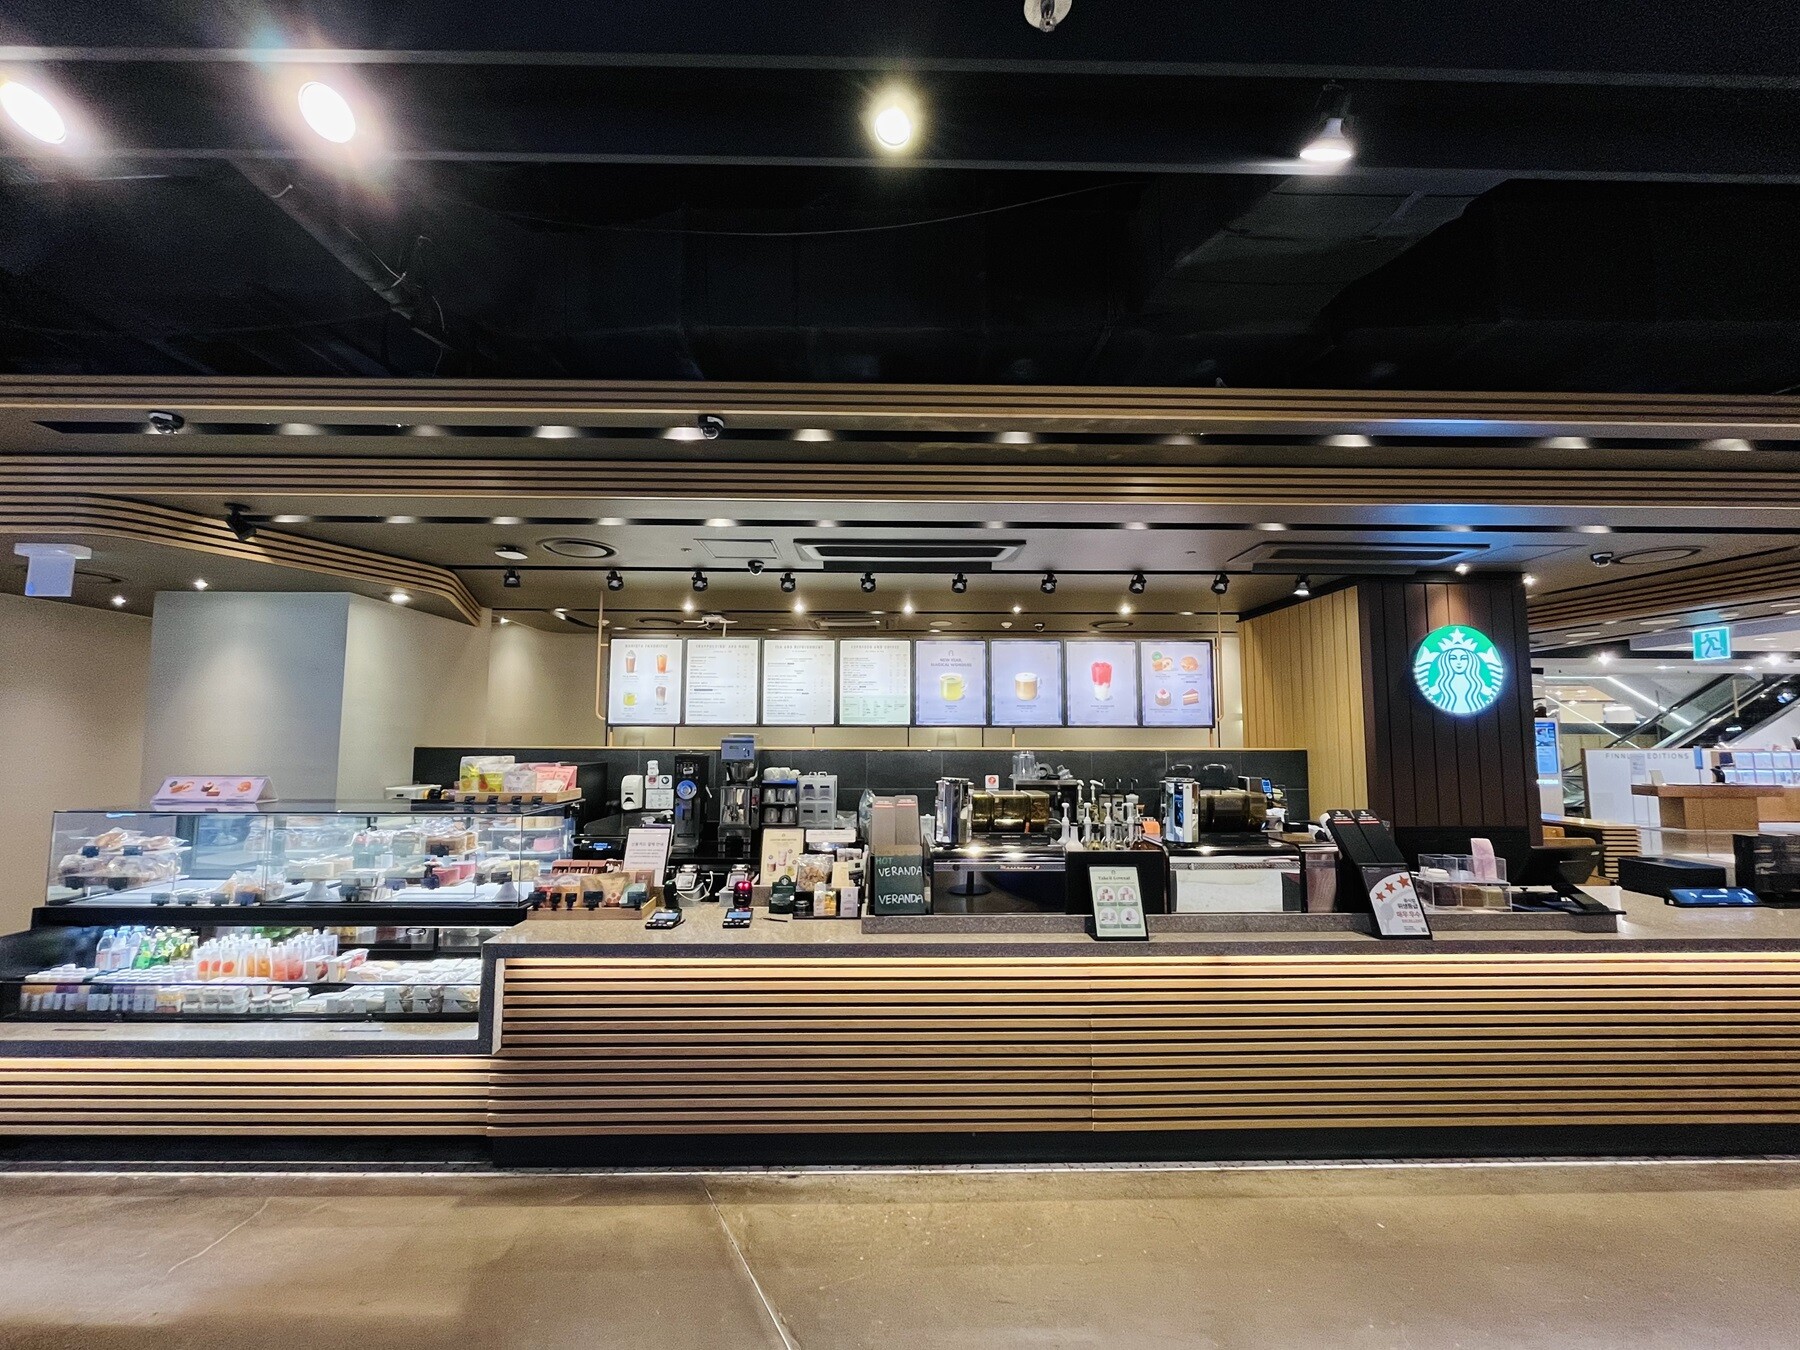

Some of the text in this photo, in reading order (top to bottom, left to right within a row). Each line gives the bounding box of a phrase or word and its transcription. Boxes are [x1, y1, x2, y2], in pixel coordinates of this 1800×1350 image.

[875, 857, 893, 865] HOT
[878, 865, 923, 877] VERANDA
[878, 893, 924, 905] VERANDA
